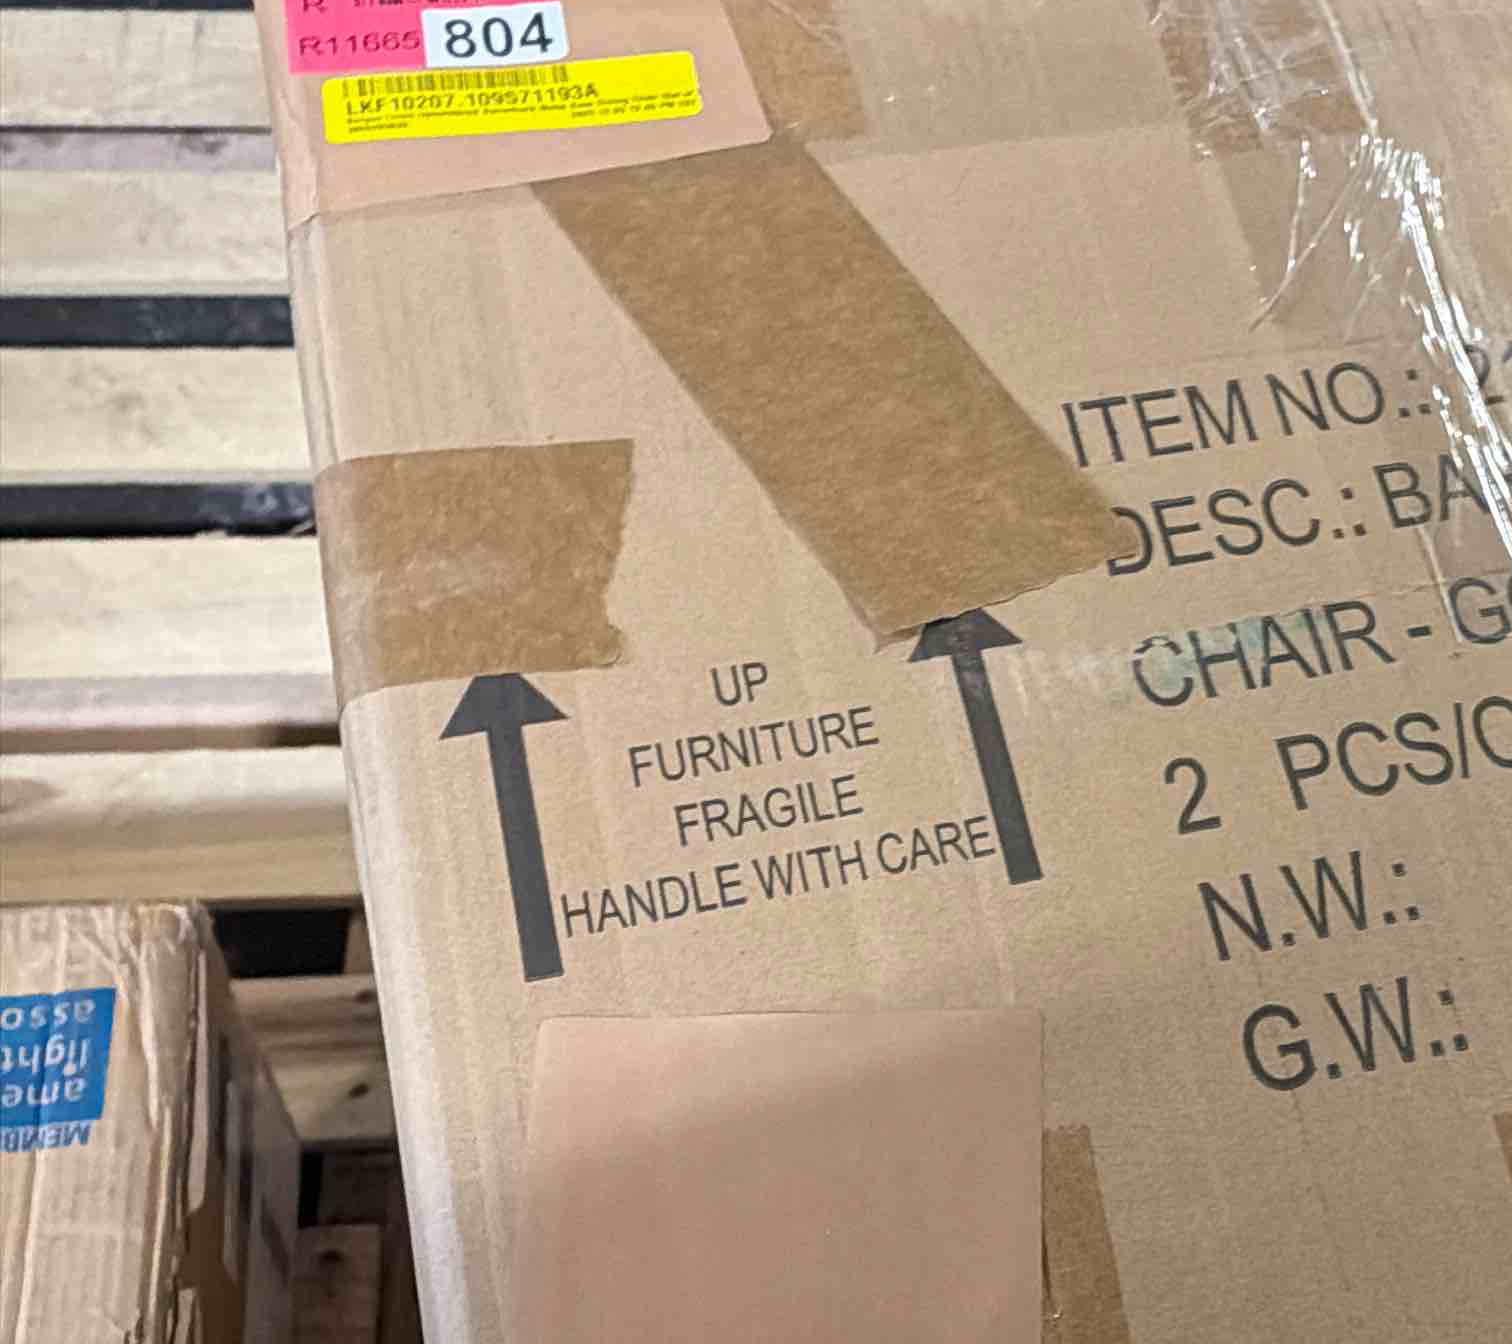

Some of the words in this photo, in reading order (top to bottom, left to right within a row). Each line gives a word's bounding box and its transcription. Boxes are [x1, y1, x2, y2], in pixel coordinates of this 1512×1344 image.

[298, 30, 421, 57] R11665
[443, 11, 554, 59] 804
[1062, 379, 1258, 468] ITEM
[710, 661, 769, 706] UP
[1132, 600, 1396, 708] CHAIR
[627, 706, 880, 787] FURNITURE
[673, 774, 864, 847] FRAGILE
[1163, 756, 1223, 835] 2
[560, 862, 748, 938] HANDLE
[751, 842, 870, 902] WITH
[875, 814, 996, 874] CARE
